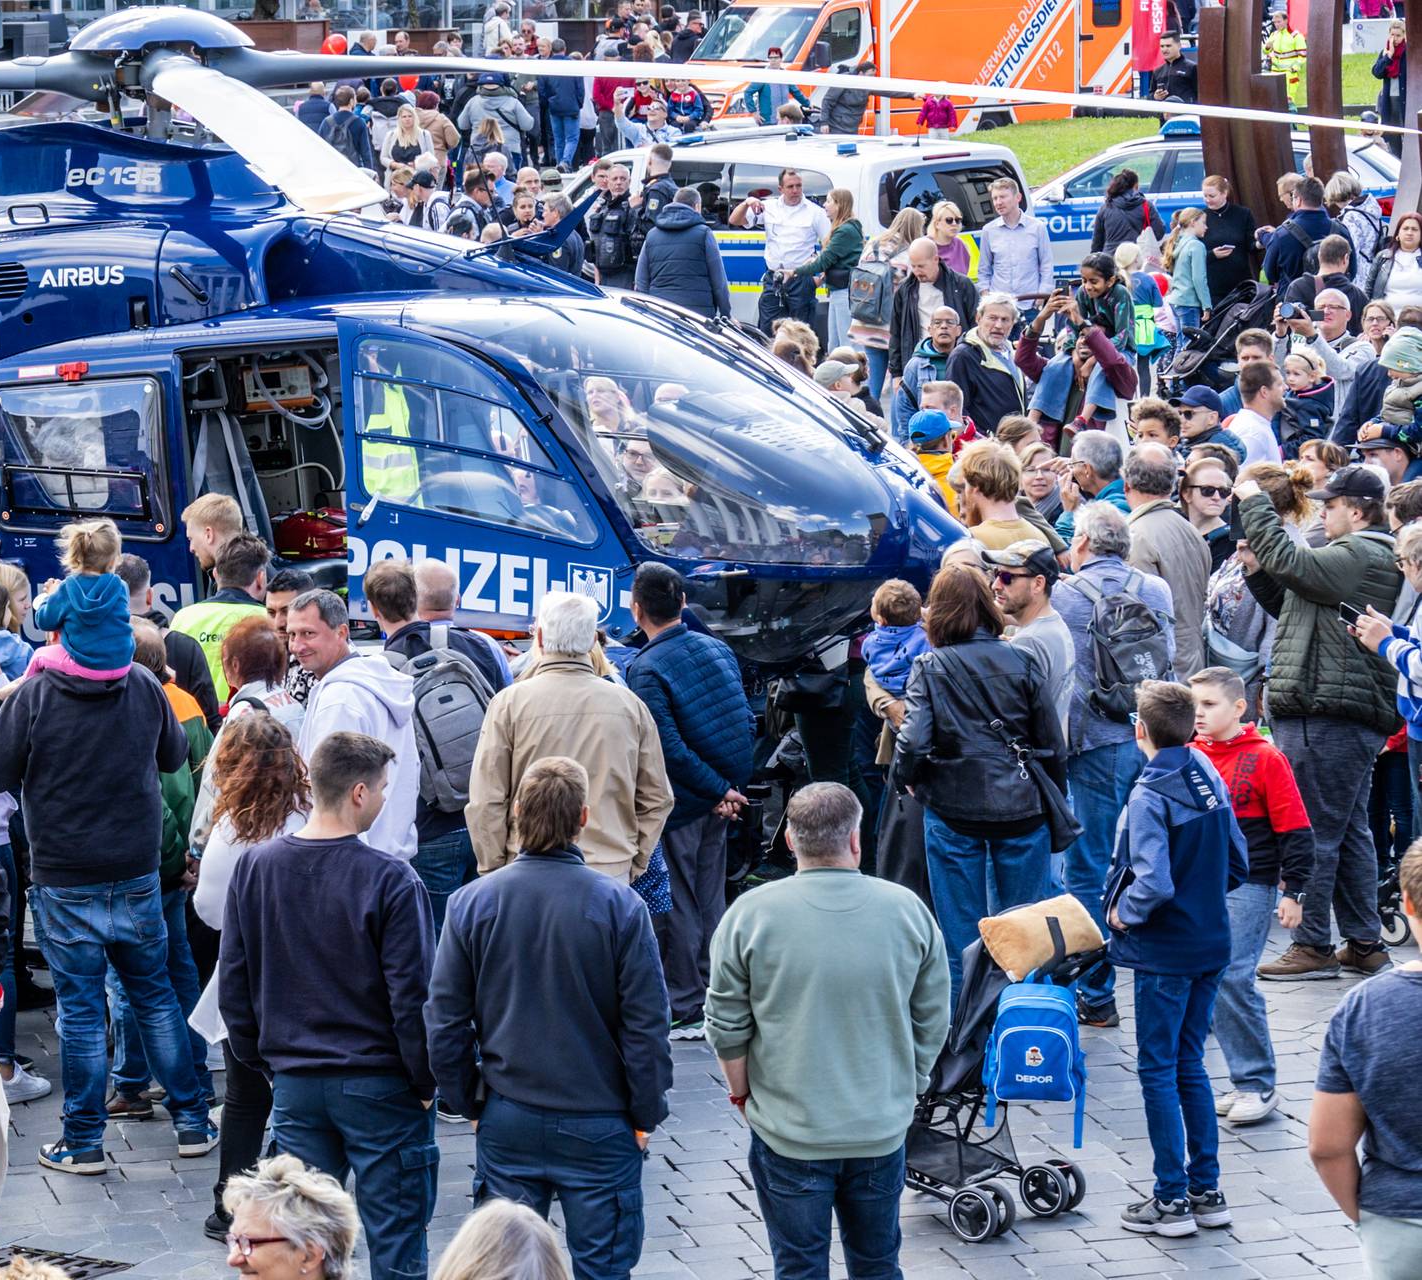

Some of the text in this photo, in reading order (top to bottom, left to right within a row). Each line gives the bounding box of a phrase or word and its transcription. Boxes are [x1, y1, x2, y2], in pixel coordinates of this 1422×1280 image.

[989, 0, 1058, 87] ETTUNGSDIE
[1043, 40, 1064, 64] 112
[108, 166, 162, 186] 135
[38, 265, 125, 288] AIRBUS
[347, 536, 548, 617] PZEI
[1015, 1074, 1053, 1083] DEPOR
